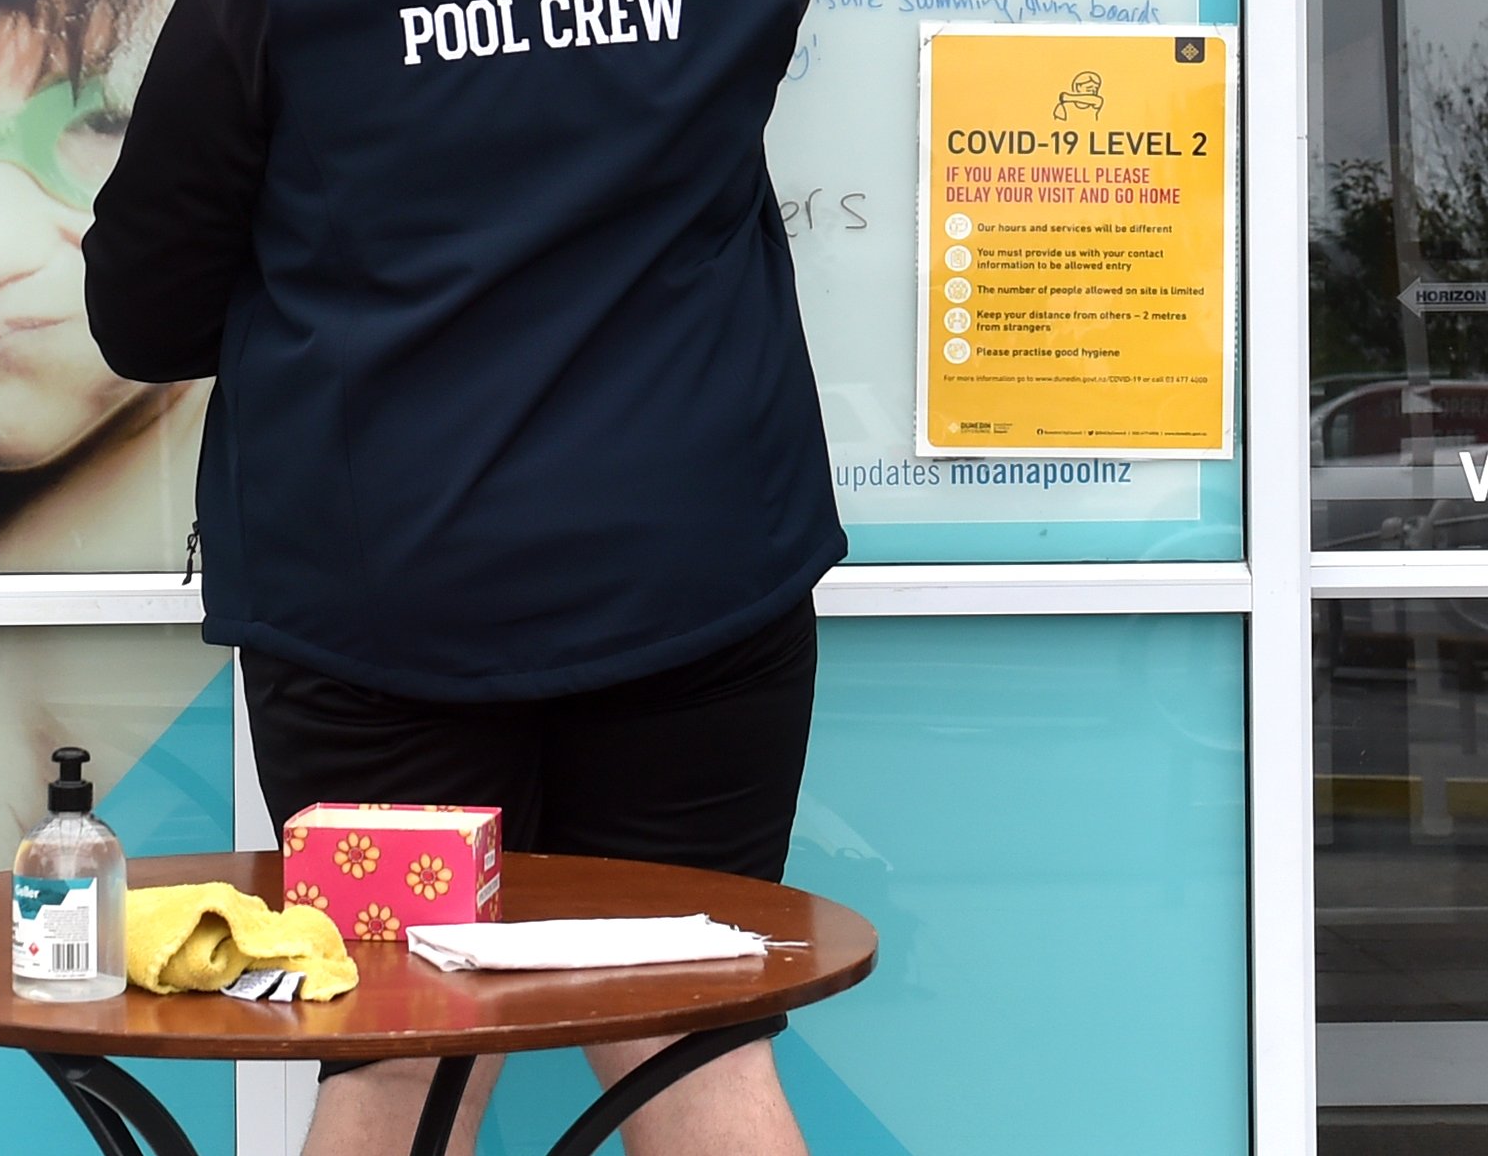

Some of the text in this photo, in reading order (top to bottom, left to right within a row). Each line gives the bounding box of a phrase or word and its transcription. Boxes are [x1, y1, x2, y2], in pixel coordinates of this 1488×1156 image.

[947, 130, 1208, 156] COVID-19 LEVEL 2
[946, 166, 1150, 184] IF YOU ARE UNWELL PLEASE
[946, 187, 1181, 205] DELAY YOUR VISIT AND GO HOME
[977, 224, 1172, 233] Our hours and services will be different
[977, 249, 1164, 260] You must provide us with your contact
[977, 261, 1132, 272] information to be allowed entry
[977, 285, 995, 294] The
[997, 285, 1035, 294] number
[1038, 285, 1048, 294] of
[1050, 286, 1083, 297] people
[1085, 286, 1123, 295] allowed
[1140, 286, 1157, 295] site
[1160, 286, 1168, 295] is
[1171, 286, 1205, 296] limited
[1415, 290, 1487, 302] HORIZON
[976, 310, 1001, 321] Keep
[1004, 311, 1026, 321] your
[1029, 310, 1071, 320] distance
[1073, 310, 1097, 320] from
[1099, 310, 1132, 320] others
[1143, 311, 1149, 320] 2
[1151, 311, 1187, 320] metres
[976, 323, 1051, 334] from strangers
[976, 348, 1120, 360] Please practise good hygiene
[943, 374, 955, 382] For
[976, 374, 1015, 382] information
[1152, 375, 1164, 383] call
[836, 458, 1132, 492] updates moanapoolnz
